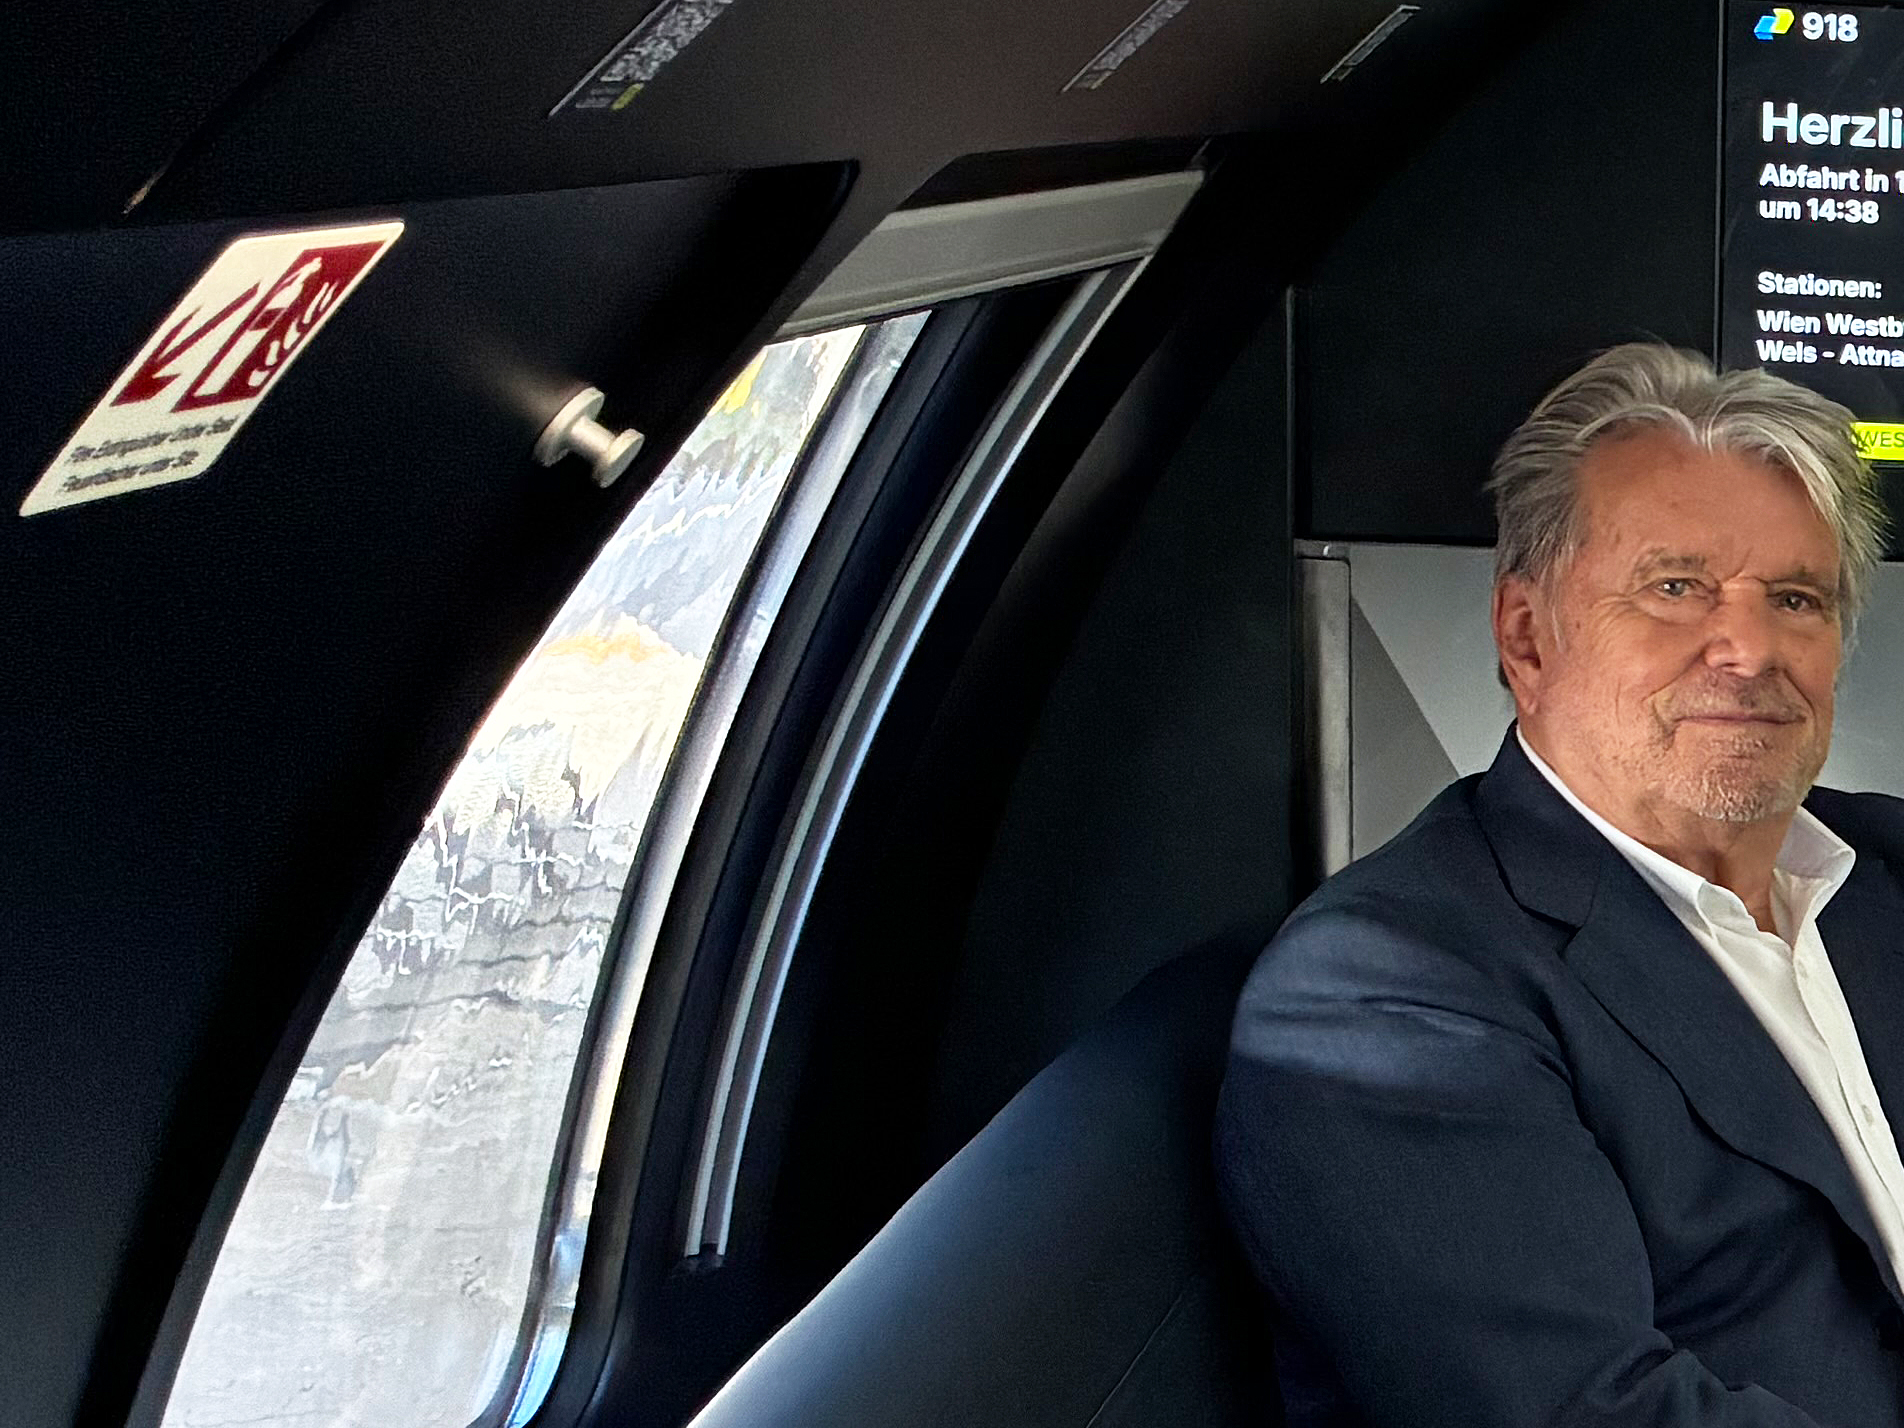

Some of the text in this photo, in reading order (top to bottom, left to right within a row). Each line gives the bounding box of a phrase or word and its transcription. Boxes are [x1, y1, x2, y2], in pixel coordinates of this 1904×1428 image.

[1802, 12, 1859, 42] 918
[1759, 163, 1860, 192] Abfahrt
[1864, 168, 1889, 194] in
[1759, 198, 1880, 224] um 14:38
[1757, 270, 1883, 299] Stationen:
[1756, 310, 1821, 334] Wien
[1755, 339, 1818, 364] Wels
